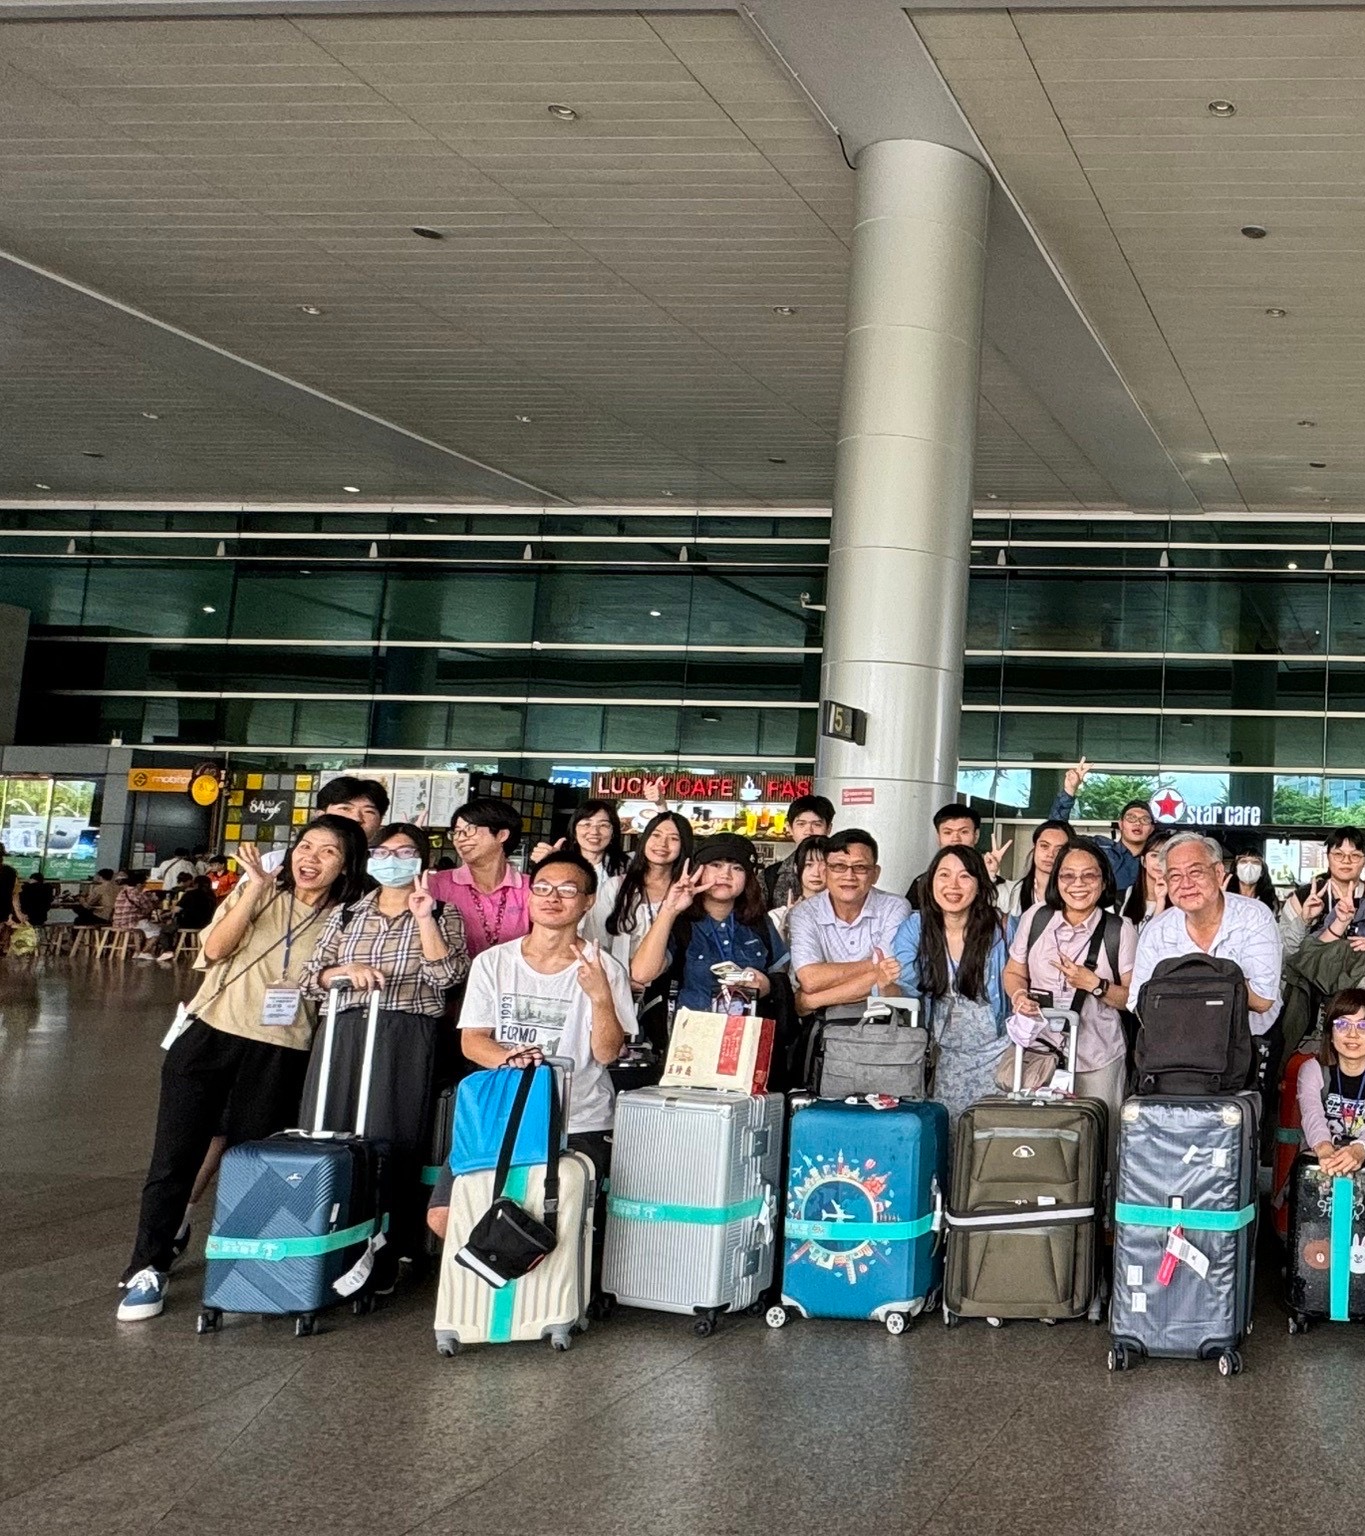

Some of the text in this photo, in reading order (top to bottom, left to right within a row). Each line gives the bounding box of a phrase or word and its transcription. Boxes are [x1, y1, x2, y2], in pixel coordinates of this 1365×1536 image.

[834, 706, 844, 732] 5
[676, 777, 734, 797] CAFE
[500, 995, 513, 1020] 1993
